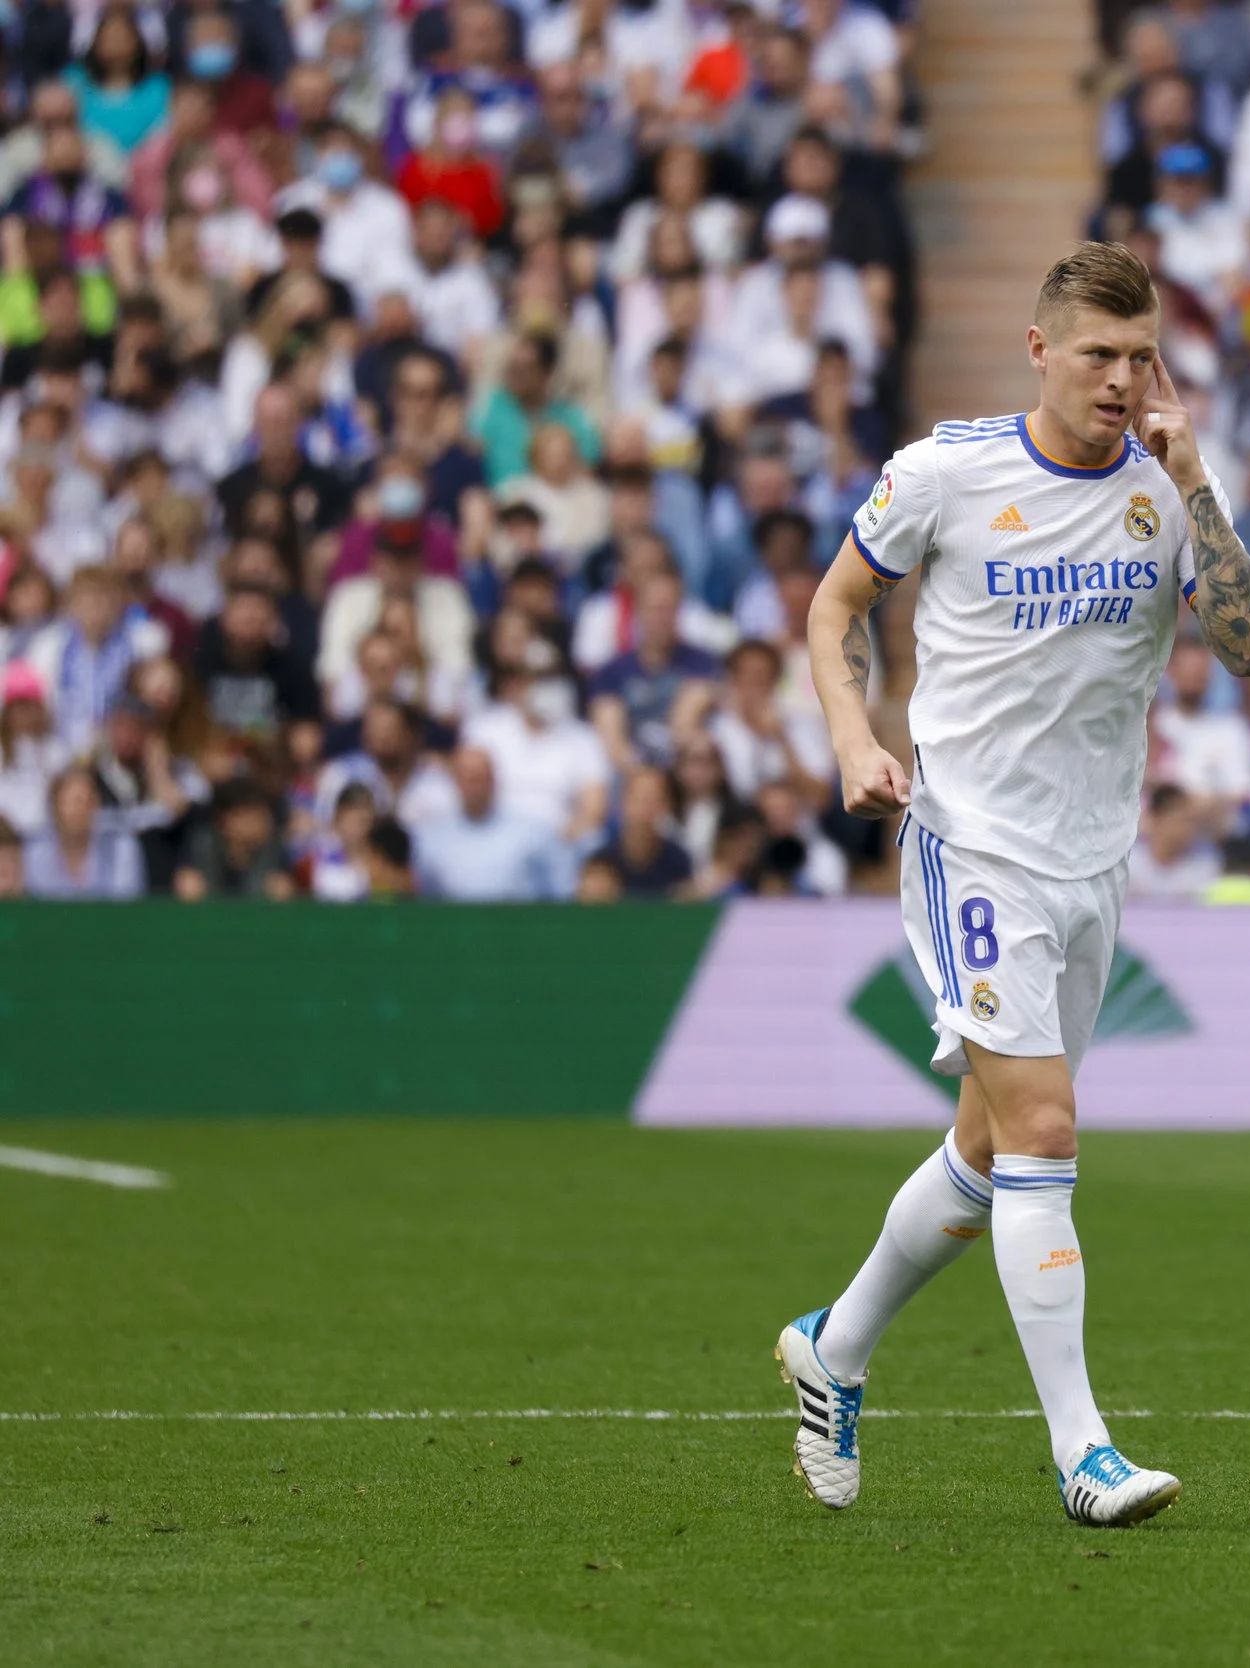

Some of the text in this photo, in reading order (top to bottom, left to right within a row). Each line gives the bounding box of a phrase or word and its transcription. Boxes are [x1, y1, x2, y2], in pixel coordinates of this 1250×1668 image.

[989, 521, 1029, 531] adidas
[985, 556, 1158, 596] Emirates
[1013, 597, 1134, 630] FLY BETTER
[958, 897, 999, 972] 8
